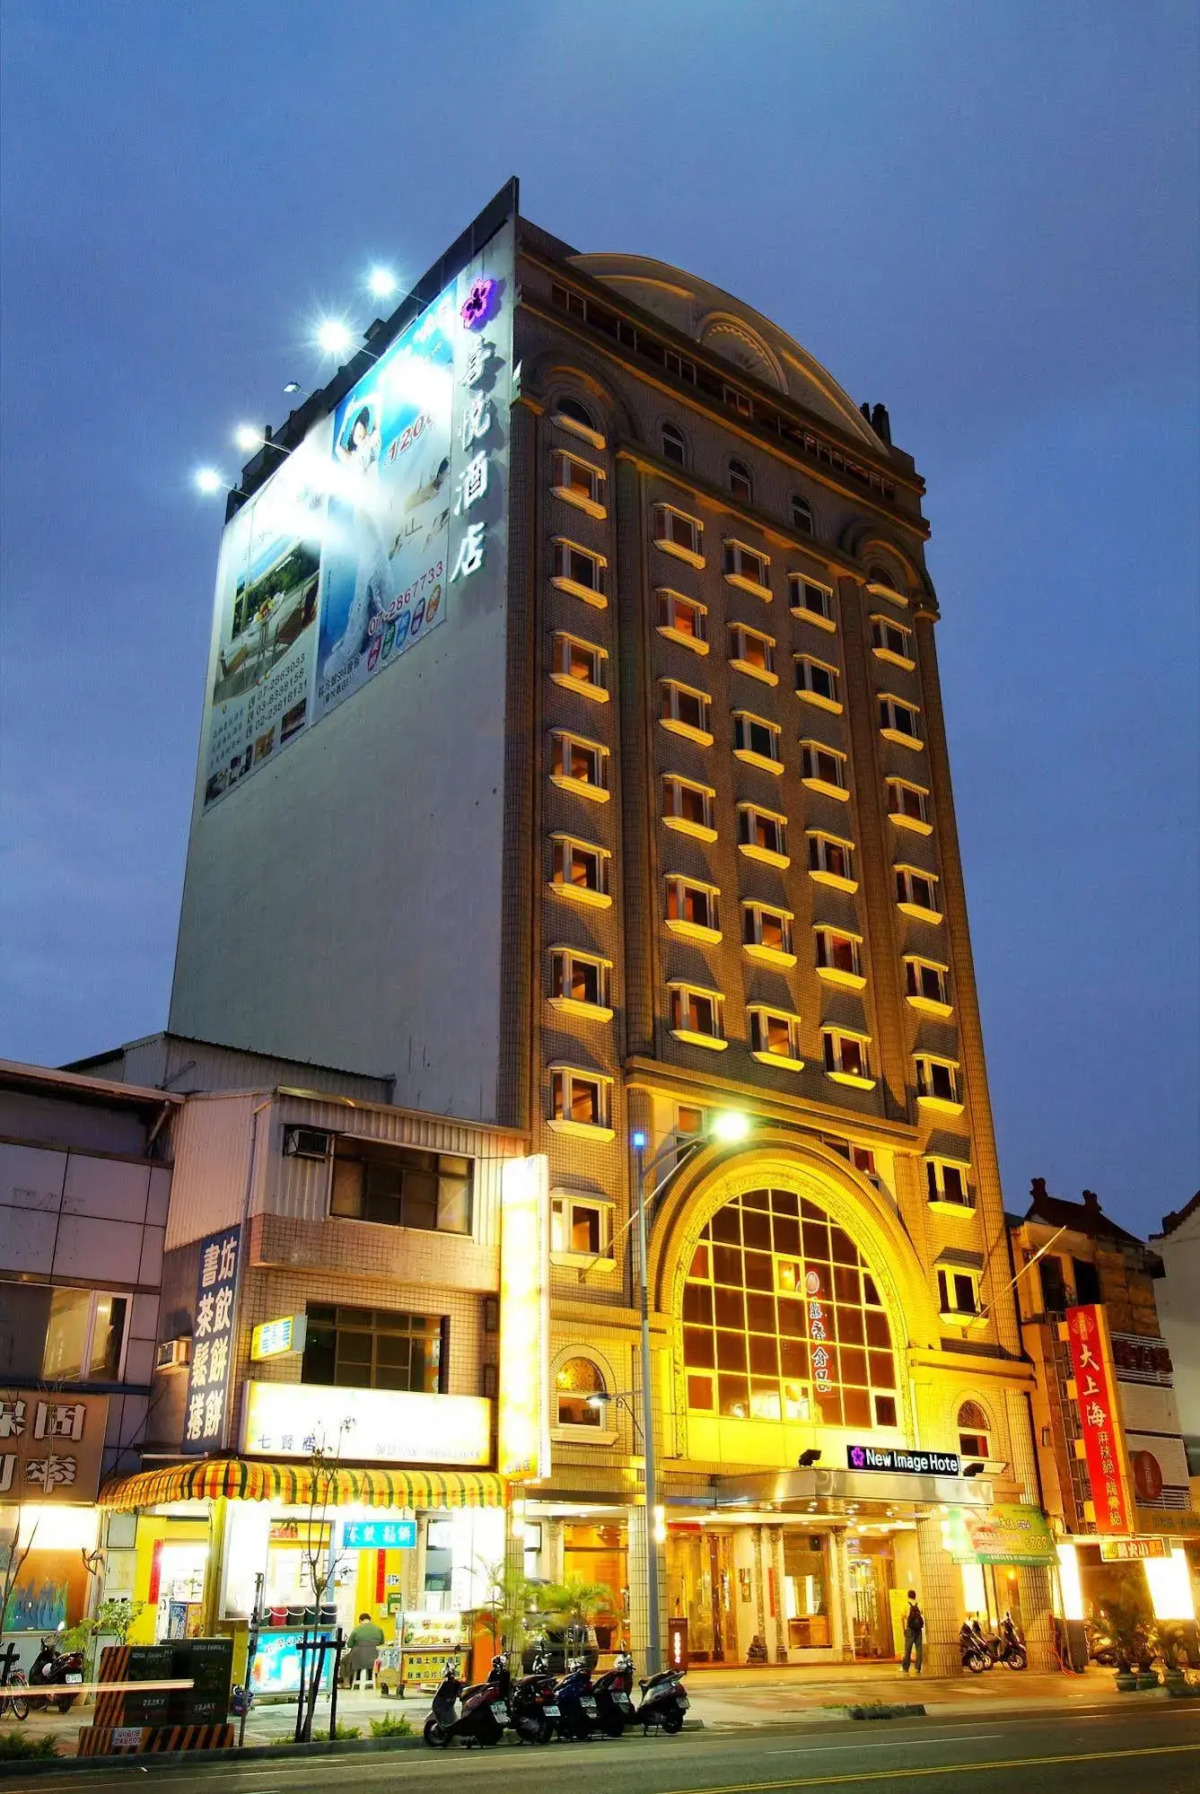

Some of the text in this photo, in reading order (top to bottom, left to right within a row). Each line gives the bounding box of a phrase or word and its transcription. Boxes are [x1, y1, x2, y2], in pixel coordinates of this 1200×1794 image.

[202, 1236, 237, 1288] 書坊
[196, 1286, 233, 1338] 茶飲
[191, 1335, 228, 1389] 鬆餅
[1080, 1343, 1106, 1427] 大上海
[866, 1448, 961, 1472] New Image Hotel
